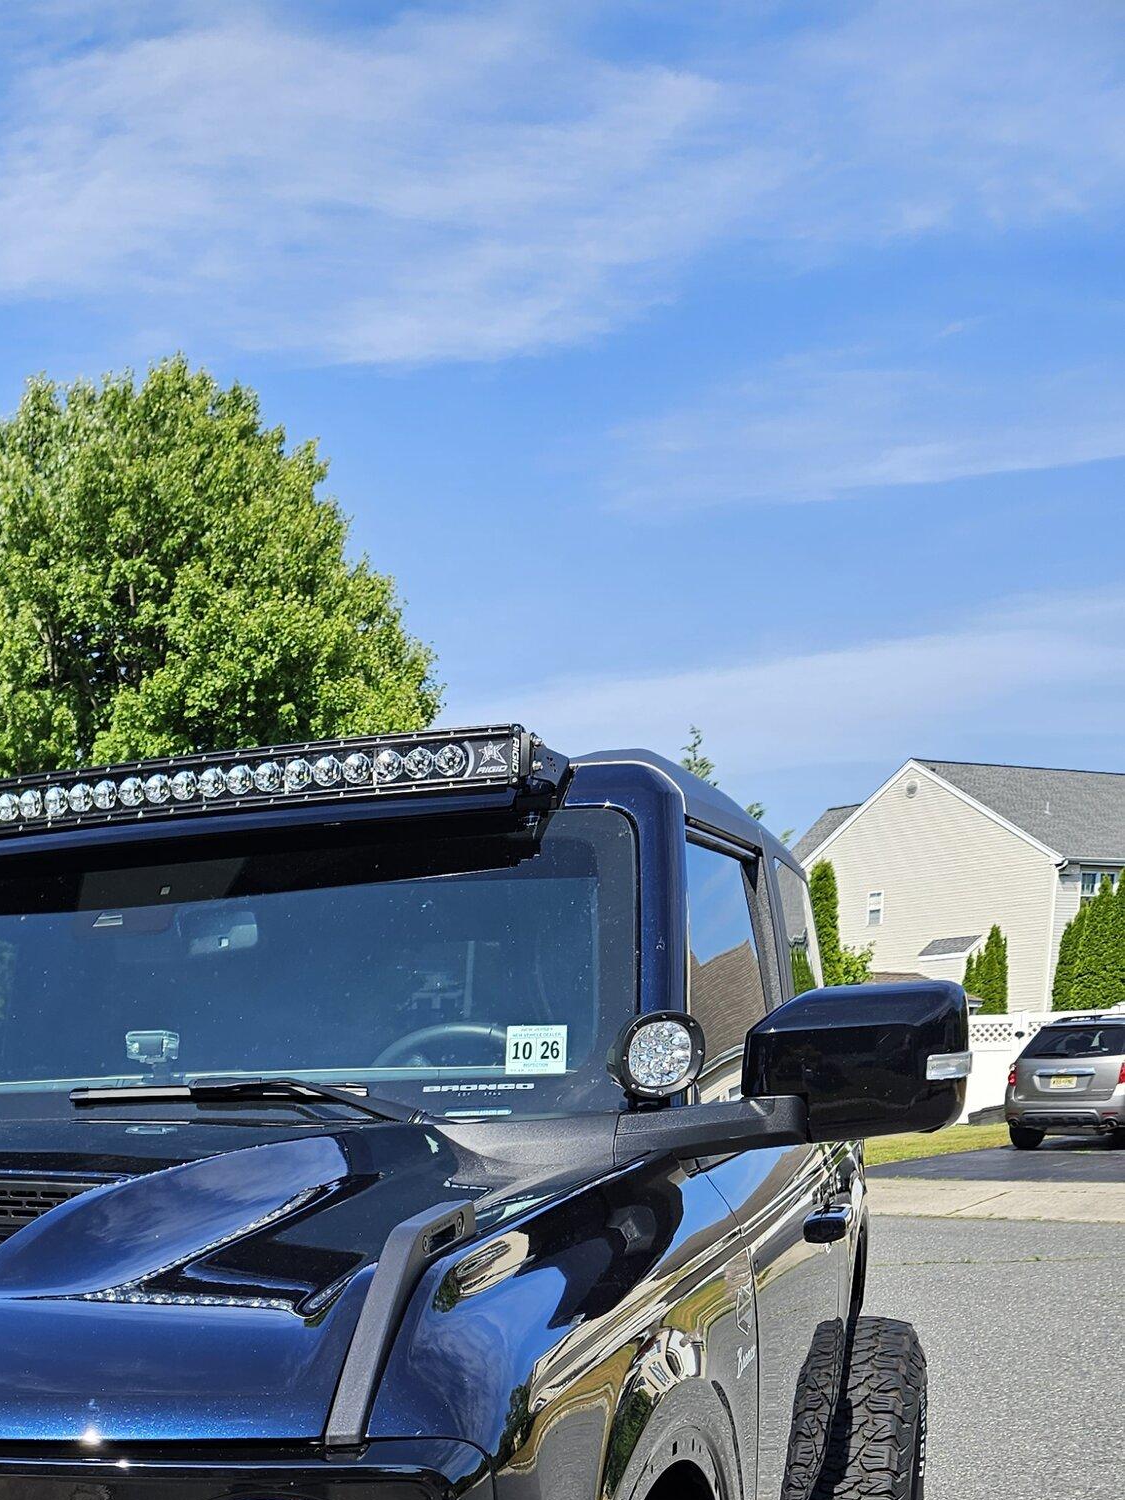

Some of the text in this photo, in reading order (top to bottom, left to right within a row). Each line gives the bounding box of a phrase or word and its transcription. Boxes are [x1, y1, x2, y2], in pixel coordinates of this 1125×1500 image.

[512, 737, 520, 773] RIGID
[476, 764, 509, 774] RIGID
[512, 1040, 560, 1060] 10 26
[422, 1083, 535, 1093] BRONCO
